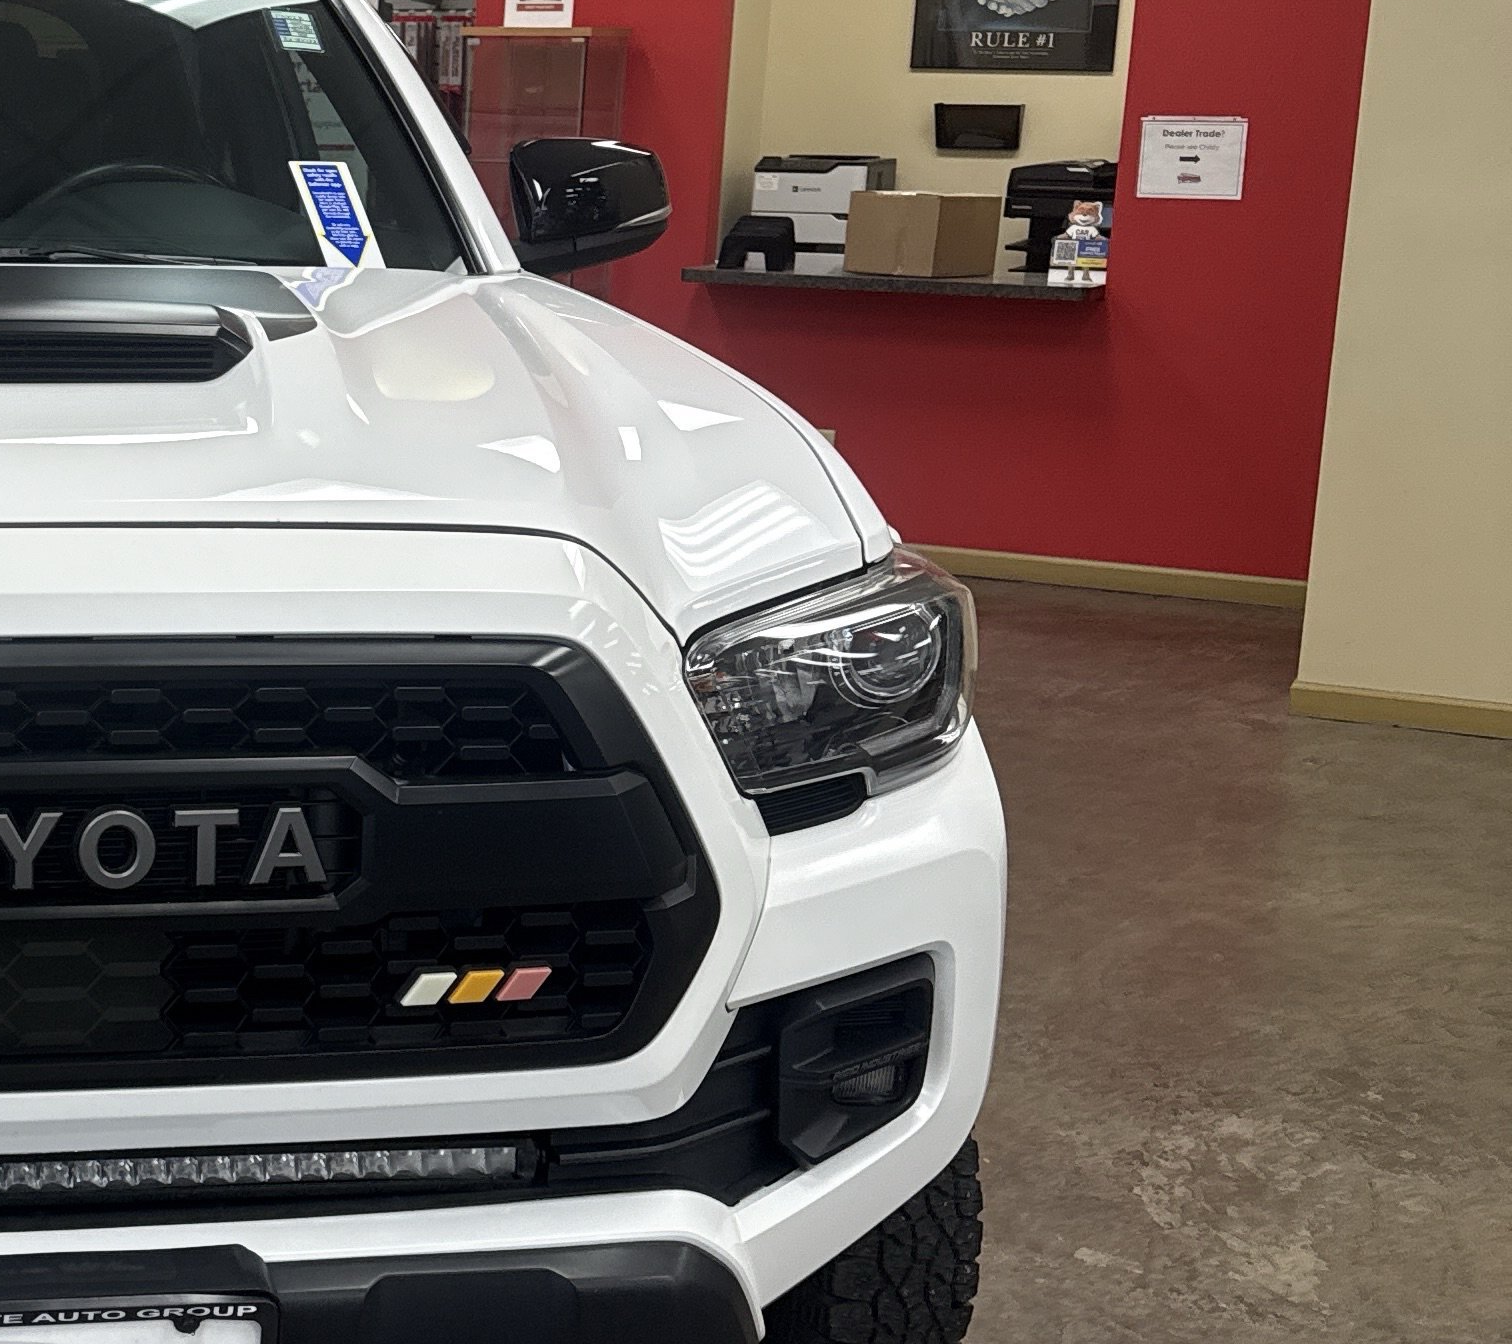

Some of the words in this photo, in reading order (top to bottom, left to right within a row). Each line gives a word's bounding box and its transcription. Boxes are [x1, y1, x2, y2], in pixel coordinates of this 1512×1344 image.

[970, 32, 1030, 47] RULE
[1035, 33, 1054, 48] #1
[1162, 129, 1193, 138] Dealer
[1195, 129, 1226, 138] Trade?
[32, 1309, 126, 1324] AUTO
[136, 1305, 258, 1320] GROUP
